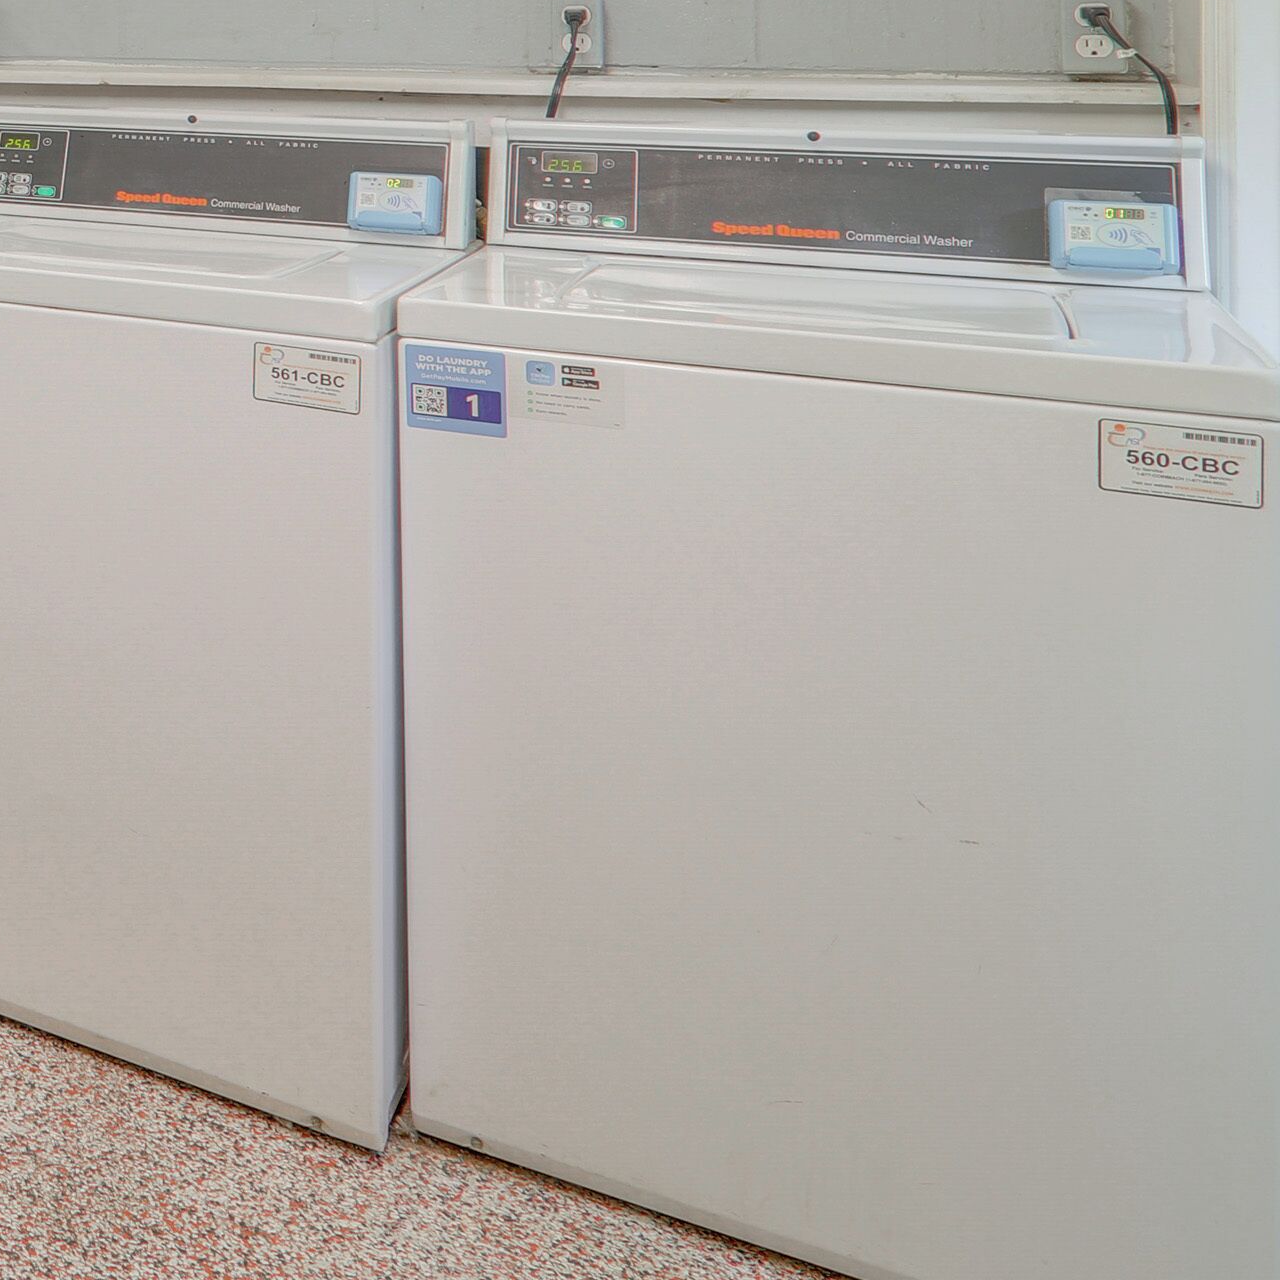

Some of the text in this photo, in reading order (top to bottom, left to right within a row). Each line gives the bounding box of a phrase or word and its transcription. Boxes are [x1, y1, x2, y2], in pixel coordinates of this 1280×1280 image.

[5, 138, 30, 149] 256
[183, 136, 216, 144] PRESS
[279, 141, 320, 149] FABRIC
[547, 158, 583, 172] 256
[698, 153, 991, 171] PERMANENT PRESS ALL FABRIC
[387, 178, 400, 188] 02
[116, 190, 302, 214] Speed Queen Commercial Washer
[711, 220, 974, 249] Speed Queen Commercial Washer
[418, 354, 488, 368] DO LAUNDRY
[271, 366, 345, 389] 561-CBC
[415, 362, 492, 377] WITH THE APP
[465, 393, 480, 418] 1
[1126, 449, 1240, 476] 560-CBC
